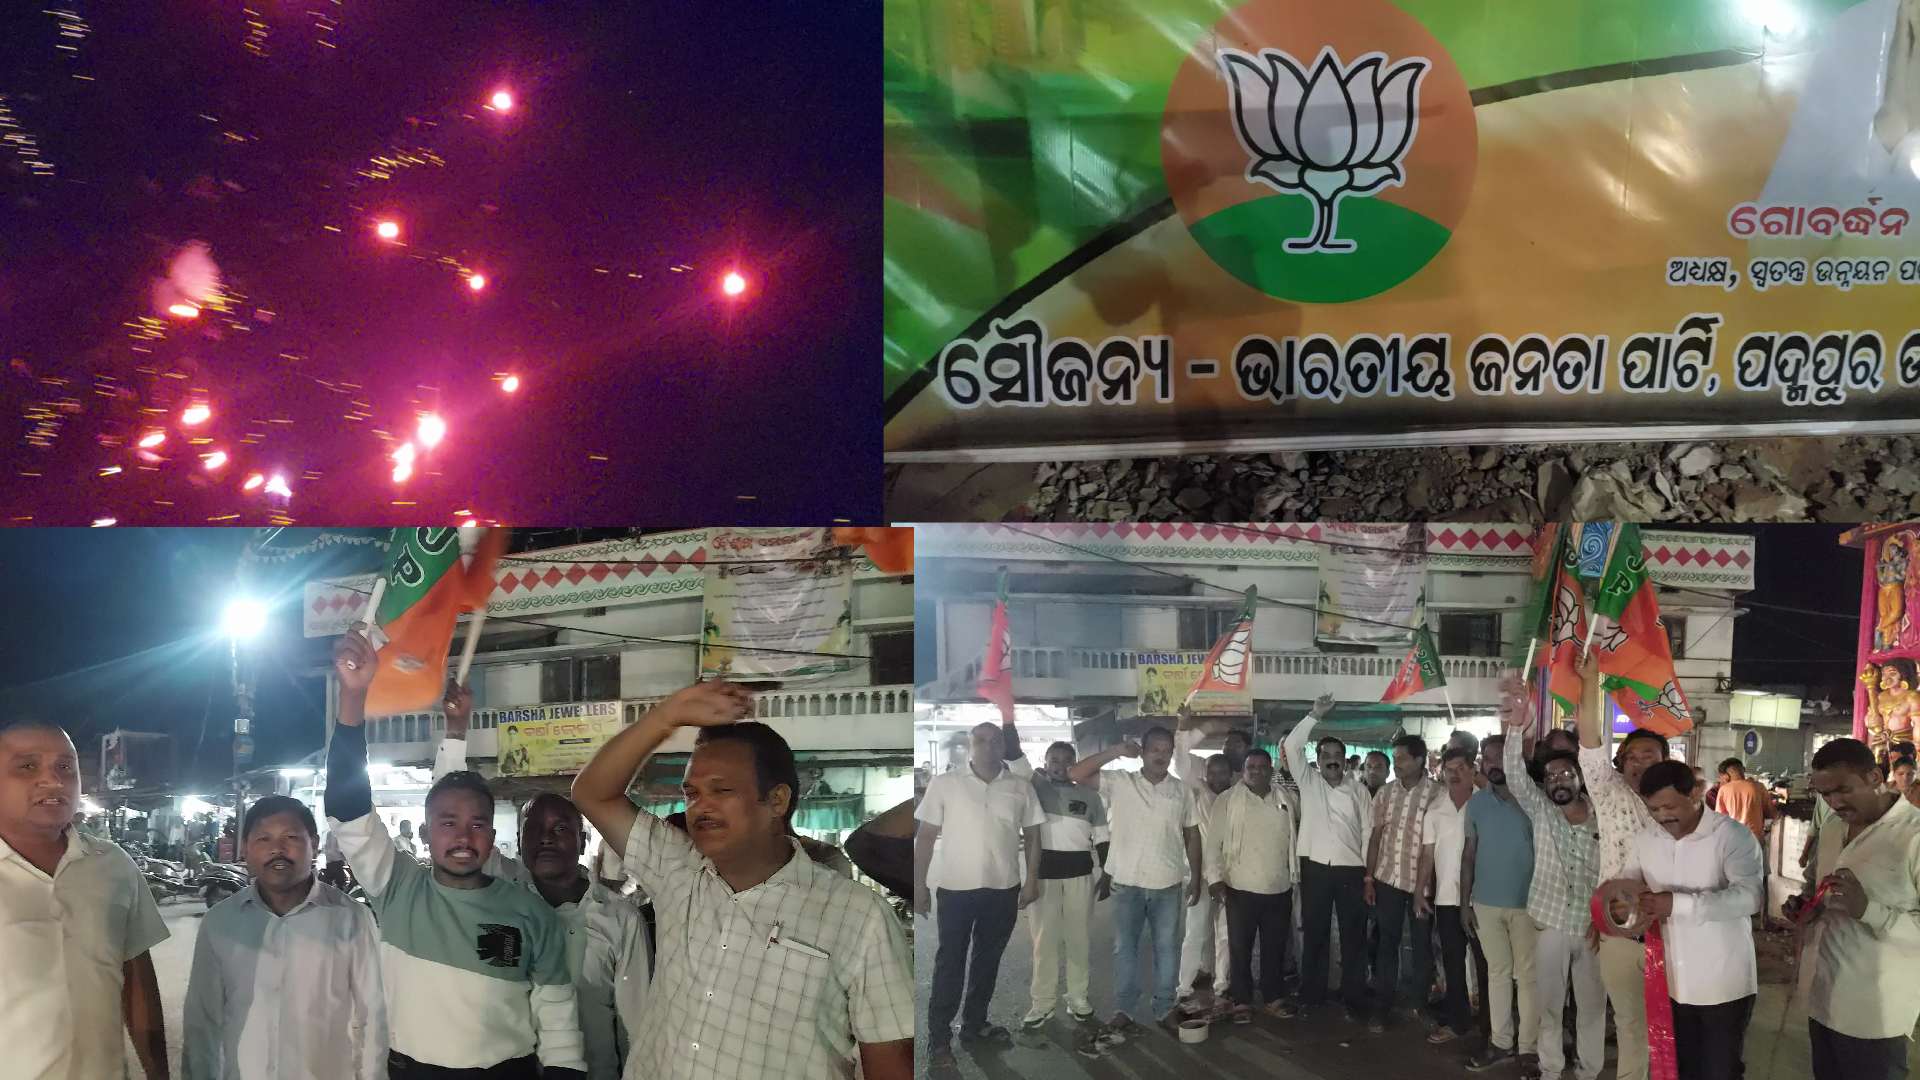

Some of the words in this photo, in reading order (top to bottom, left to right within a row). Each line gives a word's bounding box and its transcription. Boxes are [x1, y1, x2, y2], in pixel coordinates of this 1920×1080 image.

[943, 319, 1170, 404] ସୌଜନ୍ୟ
[1235, 336, 1450, 400] ଭାରତୀୟ
[1470, 335, 1607, 393] ଜନତା
[1138, 653, 1183, 665] BARSHA
[499, 709, 546, 724] BARSHA
[549, 702, 617, 720] JEWELERS
